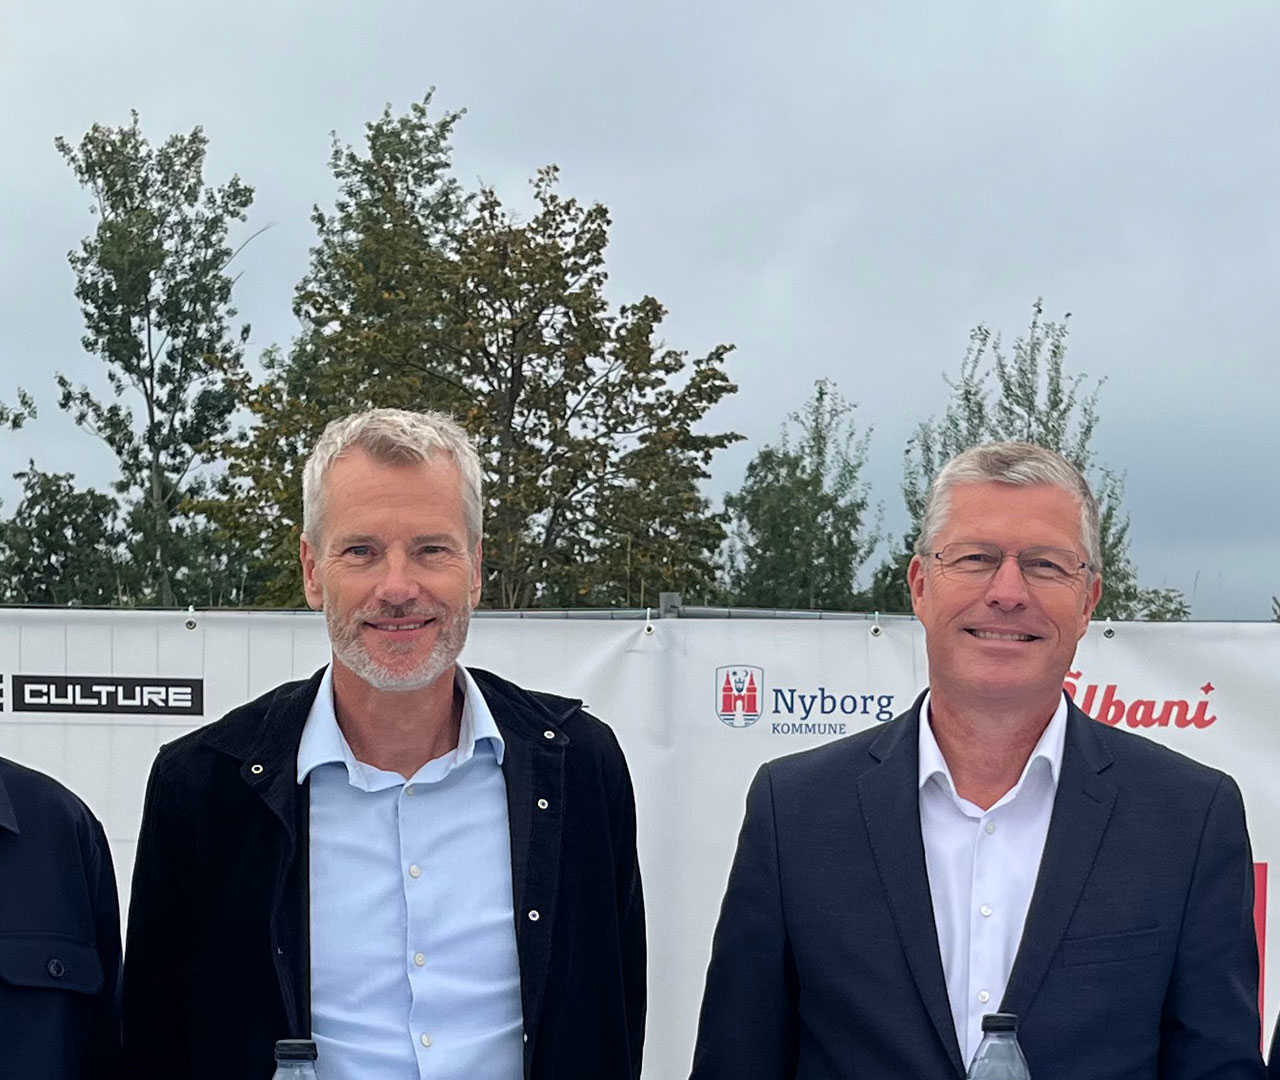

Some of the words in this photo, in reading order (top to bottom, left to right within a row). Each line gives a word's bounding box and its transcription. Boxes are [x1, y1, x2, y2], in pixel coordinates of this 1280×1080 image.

[23, 684, 192, 707] CULTURE
[771, 687, 894, 722] Nyborg
[771, 723, 846, 734] KOMMUNE
